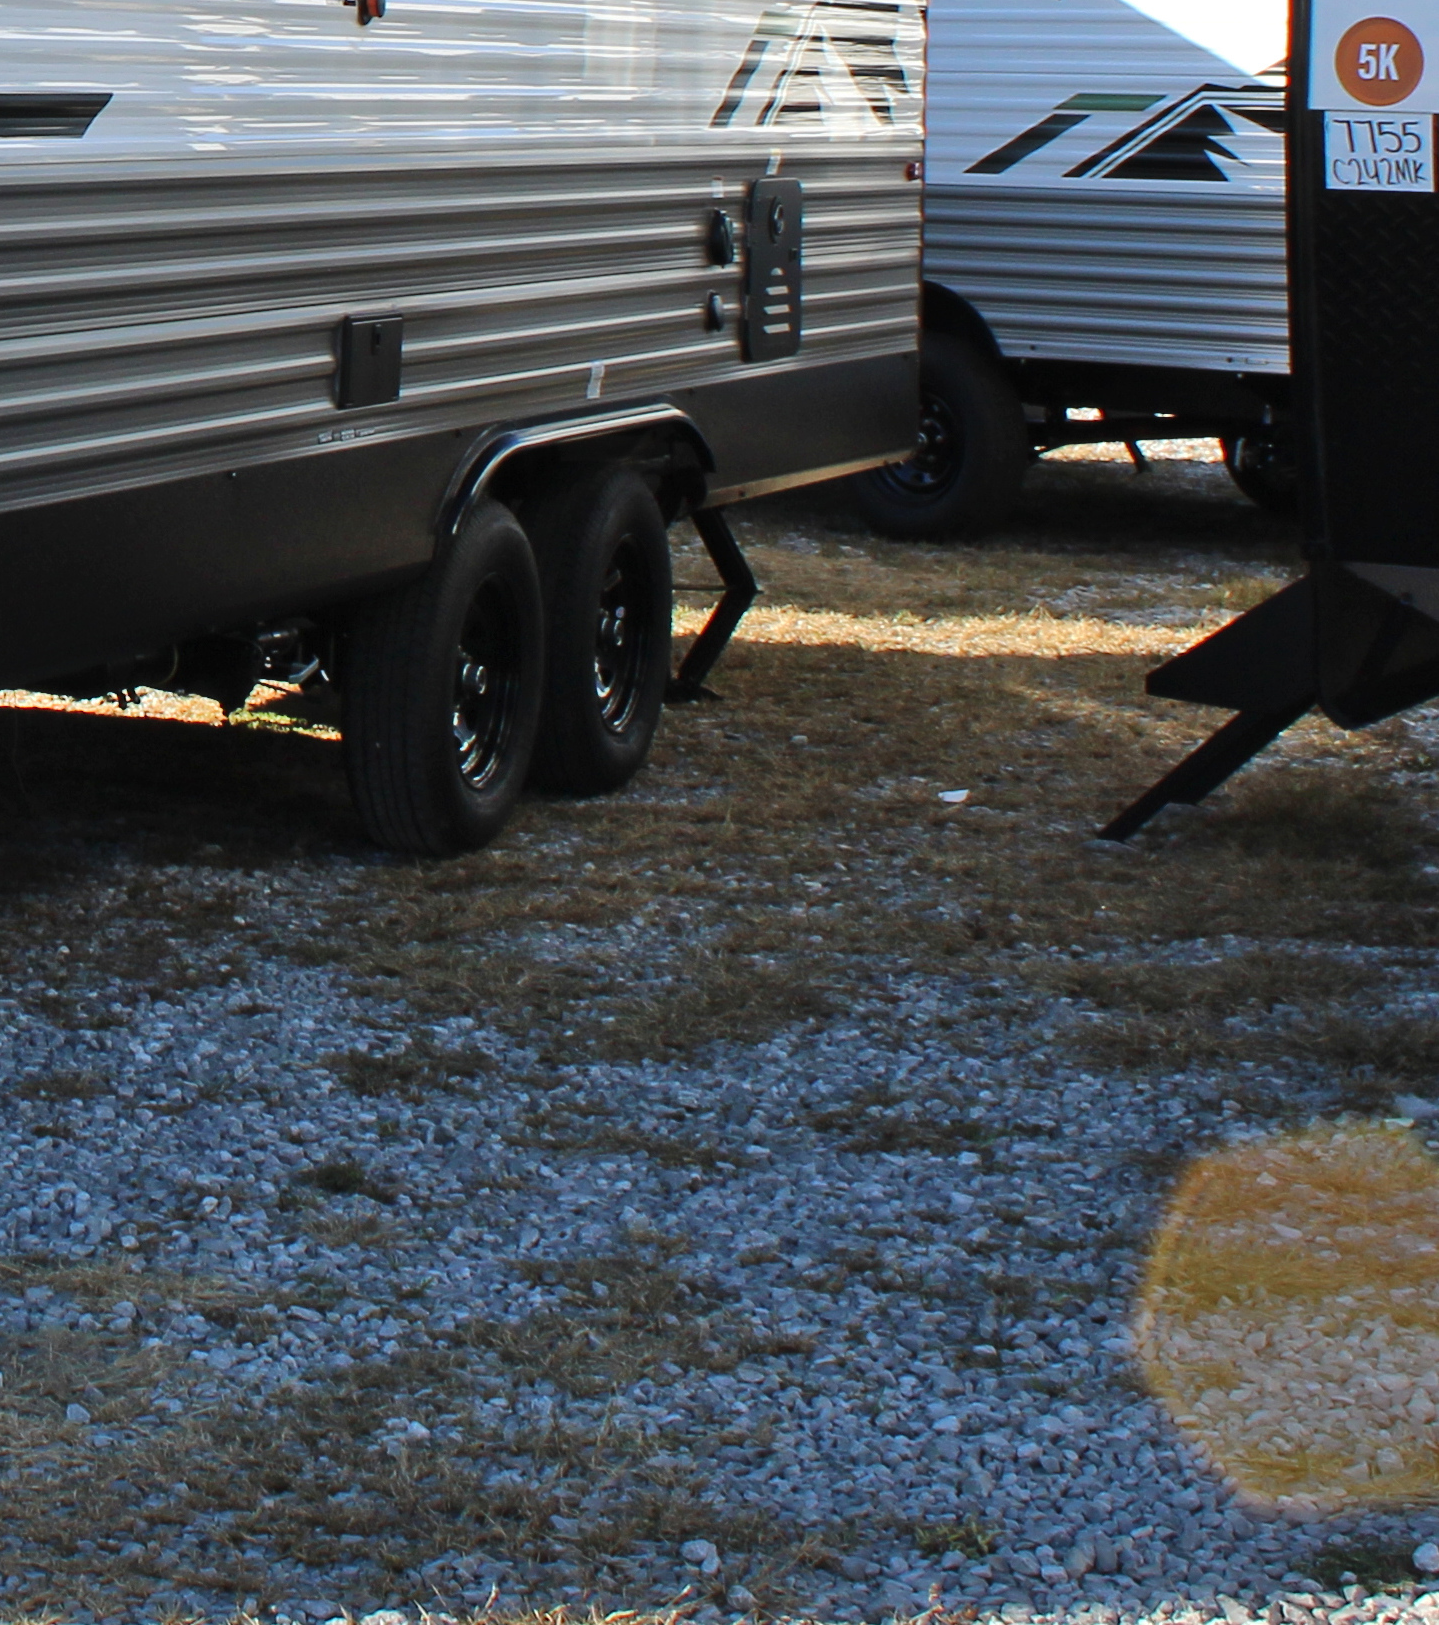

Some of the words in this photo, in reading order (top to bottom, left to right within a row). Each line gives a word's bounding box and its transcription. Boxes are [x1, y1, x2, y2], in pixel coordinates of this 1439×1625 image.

[1357, 43, 1401, 81] 5K
[1332, 119, 1422, 154] 7755
[1332, 158, 1427, 186] C242MK
